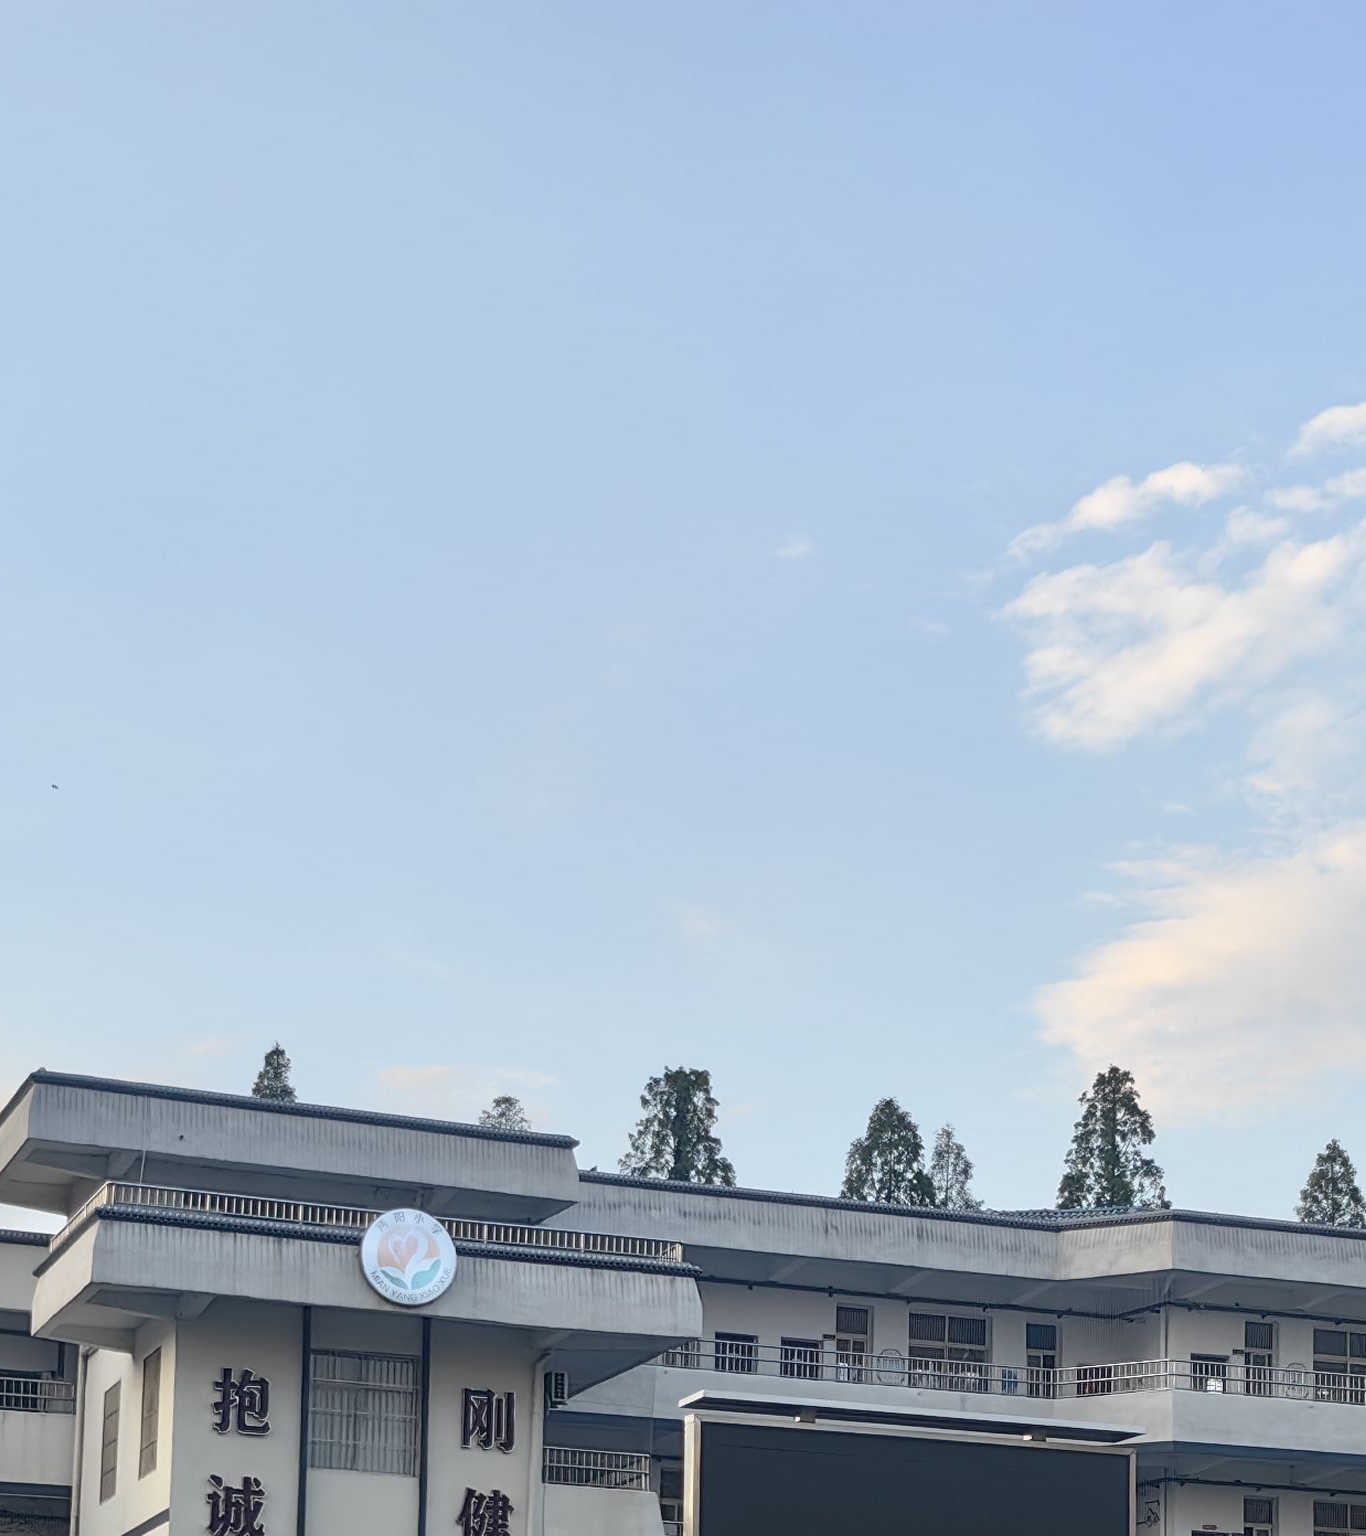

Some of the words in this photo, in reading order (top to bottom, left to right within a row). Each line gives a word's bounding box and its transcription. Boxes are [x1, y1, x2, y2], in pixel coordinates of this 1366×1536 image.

[370, 1269, 390, 1292] MIAN
[390, 1289, 418, 1302] YANG
[419, 1285, 440, 1300] XIAO
[438, 1266, 453, 1287] XUE
